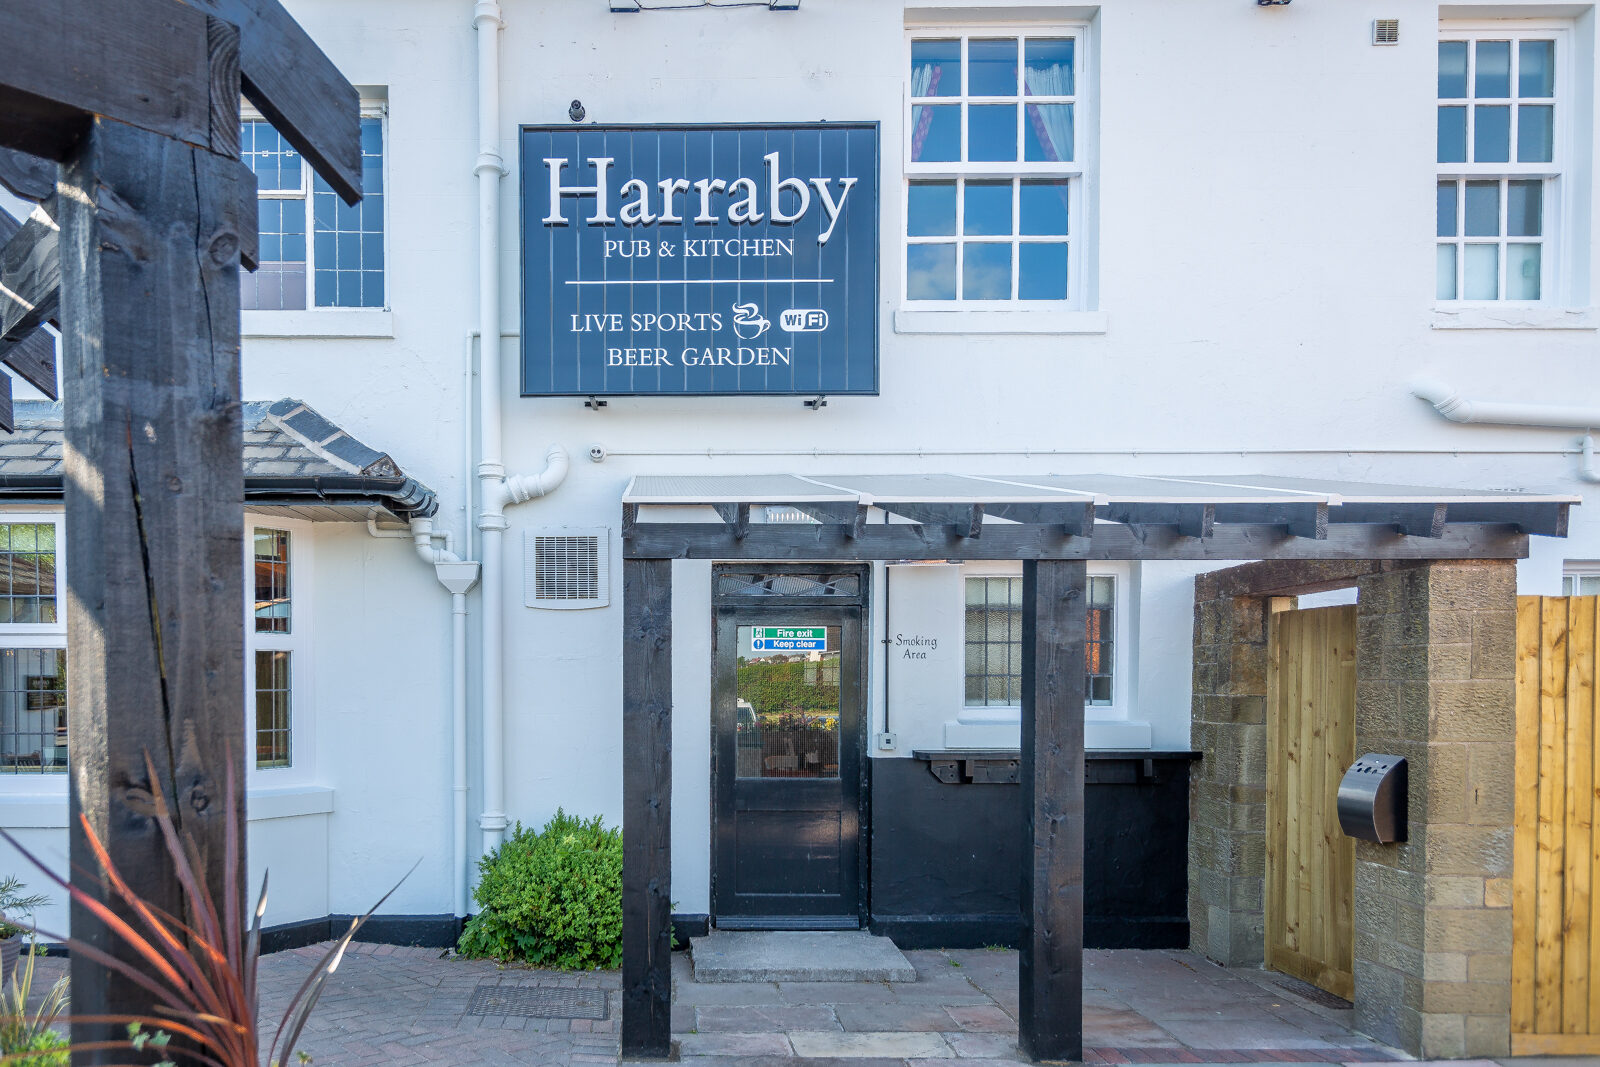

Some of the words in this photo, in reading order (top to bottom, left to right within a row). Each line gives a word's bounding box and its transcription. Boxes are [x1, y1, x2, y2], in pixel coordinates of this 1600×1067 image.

[542, 151, 858, 245] Harraby
[604, 240, 651, 258] PUB
[658, 240, 675, 257] &
[683, 239, 795, 257] KITCHEN
[570, 314, 623, 332] LIVE
[631, 313, 722, 332] SPORTS
[608, 348, 673, 367] BEER
[681, 347, 792, 366] GARDEN
[777, 629, 795, 638] Fire
[796, 629, 813, 638] exit
[896, 633, 938, 650] Smoking
[773, 640, 795, 649] Keep
[796, 640, 817, 649] clear
[903, 648, 927, 660] Area
